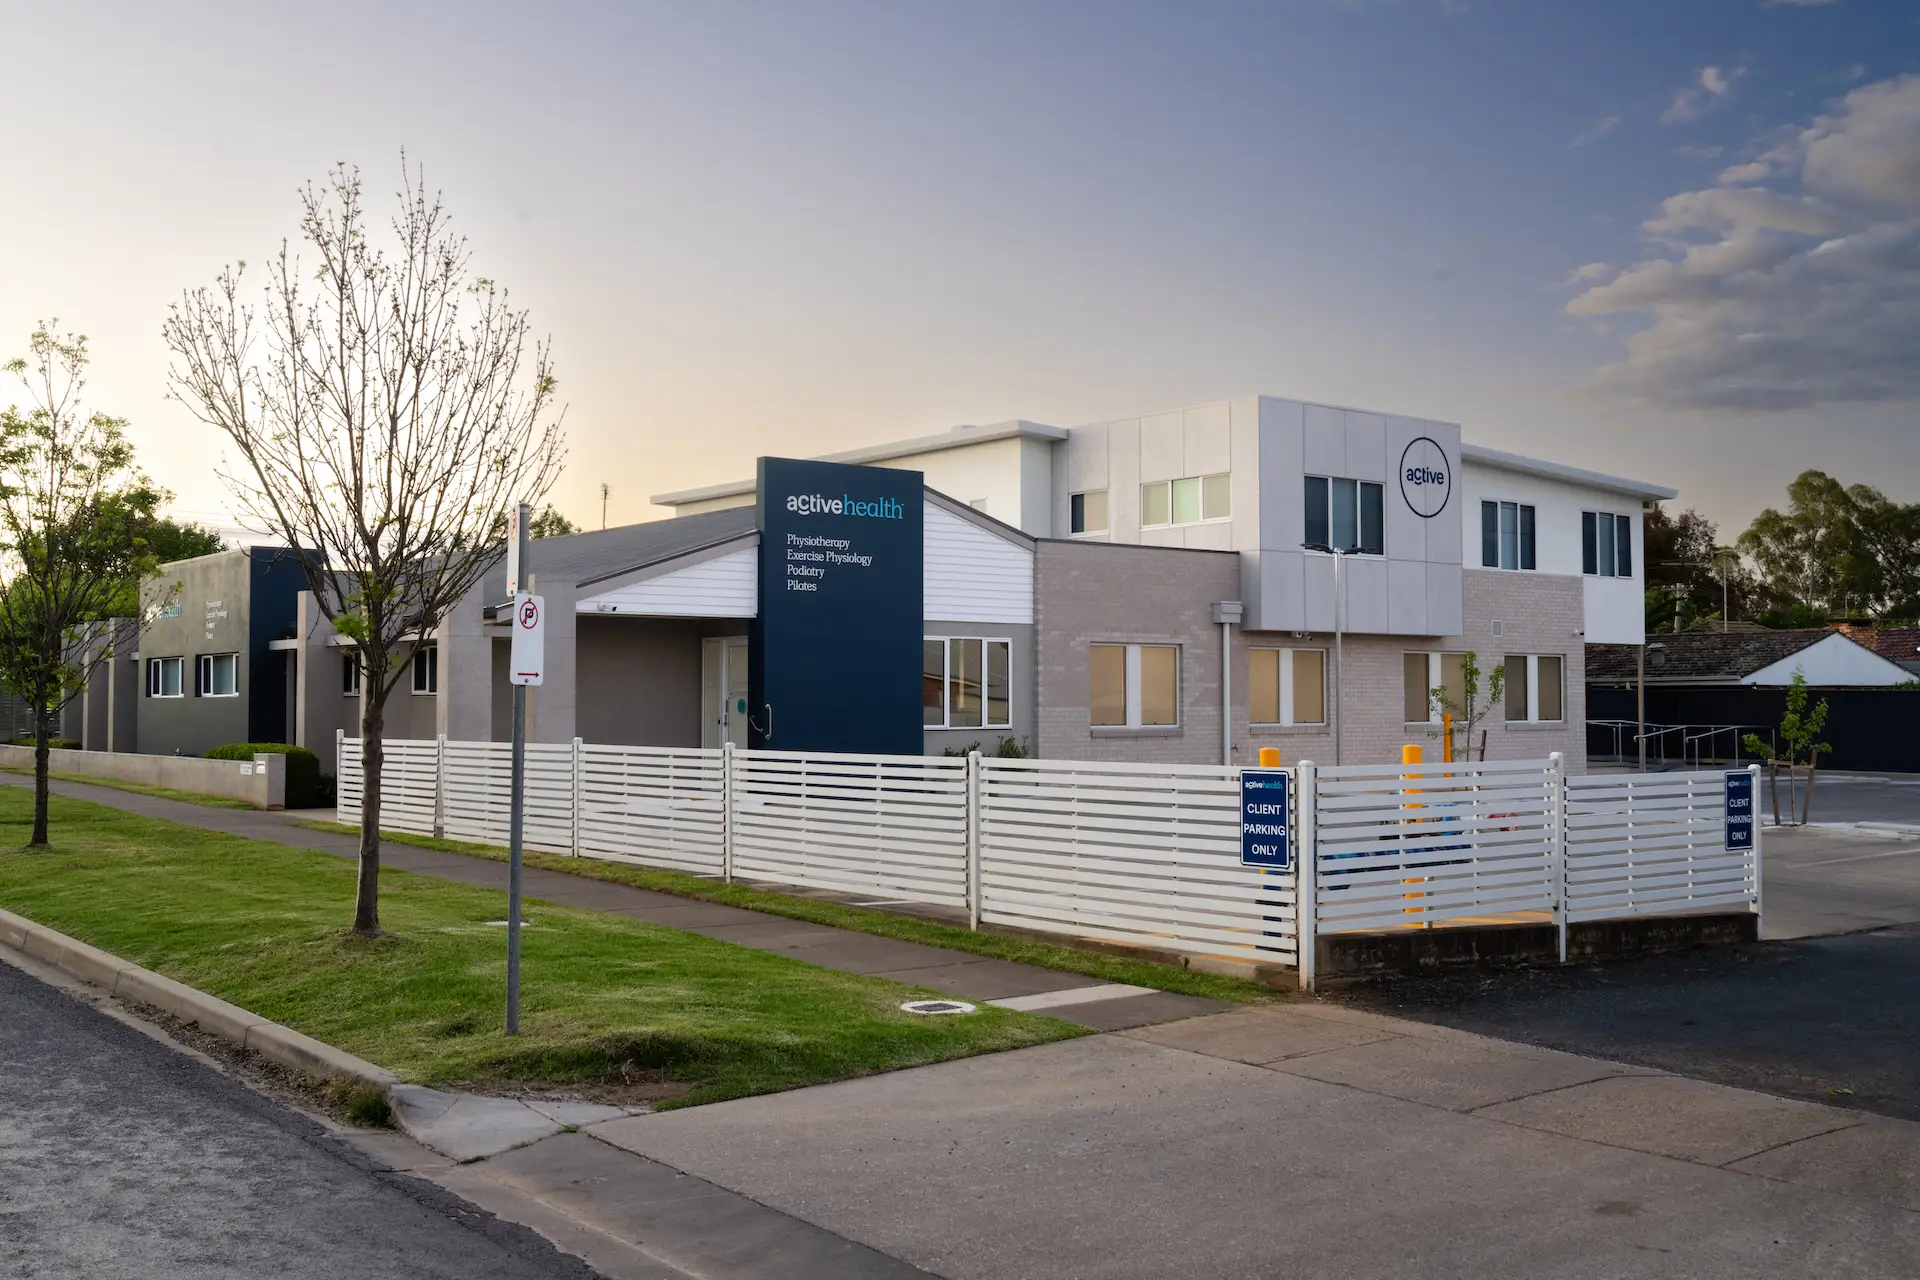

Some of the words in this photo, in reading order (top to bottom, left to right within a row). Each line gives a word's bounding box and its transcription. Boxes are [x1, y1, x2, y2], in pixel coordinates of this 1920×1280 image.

[1406, 466, 1444, 486] active
[786, 493, 904, 520] activehealth
[787, 533, 850, 550] Physiotherapy
[787, 549, 825, 562] Exercise
[825, 551, 873, 567] Physiology
[786, 564, 825, 579] Podiatry
[786, 579, 818, 592] Pilates
[1244, 781, 1283, 790] activehealth
[1247, 803, 1282, 815] CLIENT
[1729, 798, 1749, 808] CLIENT
[1727, 814, 1752, 824] PARKING
[1243, 823, 1286, 836] PARKING
[1731, 831, 1747, 841] ONLY
[1251, 843, 1278, 856] ONLY
